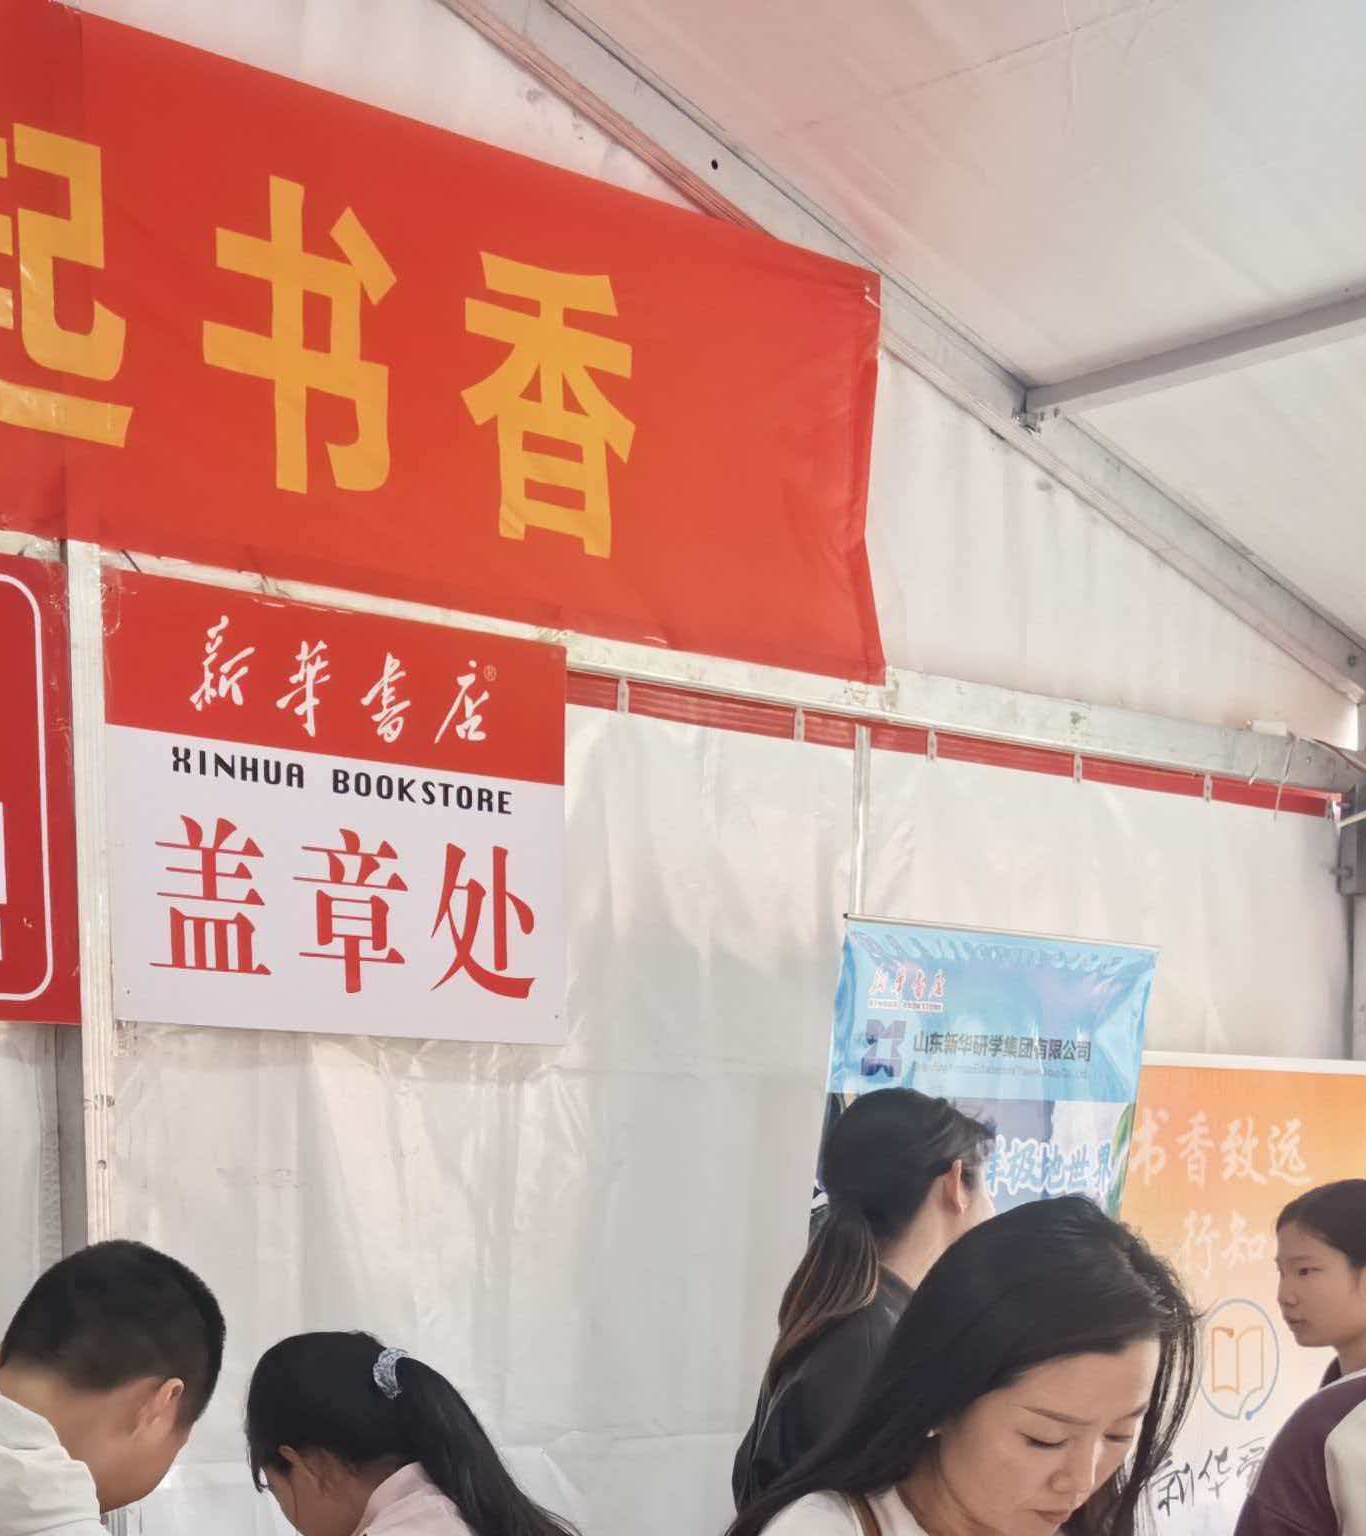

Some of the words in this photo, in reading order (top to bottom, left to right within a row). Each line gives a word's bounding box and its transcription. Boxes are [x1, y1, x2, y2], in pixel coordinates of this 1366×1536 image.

[171, 746, 305, 789] XINHUA
[332, 768, 514, 816] BOOKSTORE
[149, 815, 536, 1000] 盖章处
